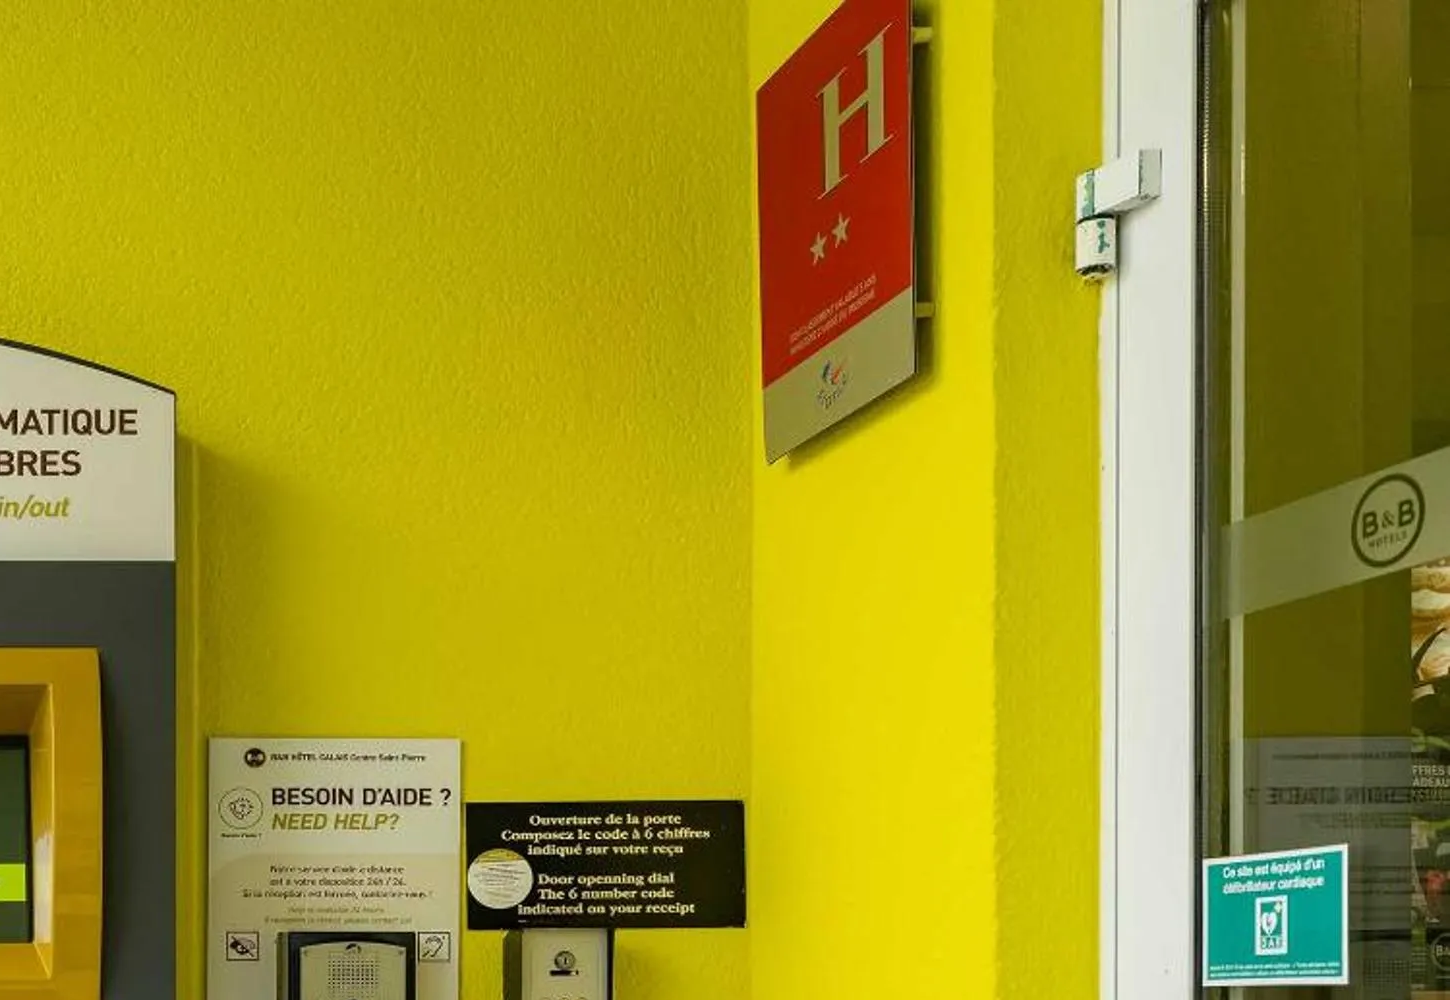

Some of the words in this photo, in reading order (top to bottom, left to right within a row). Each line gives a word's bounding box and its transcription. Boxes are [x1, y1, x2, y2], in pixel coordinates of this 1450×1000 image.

[816, 22, 895, 200] H
[272, 788, 353, 806] BESOIN
[363, 788, 432, 806] D'AIDE
[440, 788, 452, 806] ?
[271, 814, 328, 830] NEED
[333, 813, 400, 830] HELP?
[529, 814, 602, 826] Ouverture
[605, 814, 622, 825] de
[626, 813, 640, 824] la
[643, 814, 682, 827] porte
[501, 830, 575, 843] Composez
[578, 829, 590, 840] le
[595, 829, 629, 840] code
[632, 828, 641, 840] à
[644, 829, 653, 840] 6
[656, 828, 711, 840] chiffres
[527, 844, 583, 857] indiqué
[585, 846, 608, 855] sur
[612, 845, 648, 855] votre
[652, 845, 684, 857] reçu
[1223, 866, 1236, 878] Ce
[1254, 863, 1269, 875] est
[1303, 858, 1325, 870] d'un
[537, 873, 574, 885] Door
[647, 873, 675, 884] dial
[537, 888, 565, 900] The
[568, 888, 577, 900] 6
[581, 888, 637, 899] number
[640, 887, 675, 899] code
[517, 903, 583, 915] indicated
[587, 905, 606, 915] on
[610, 905, 641, 918] your
[645, 902, 695, 916] receipt
